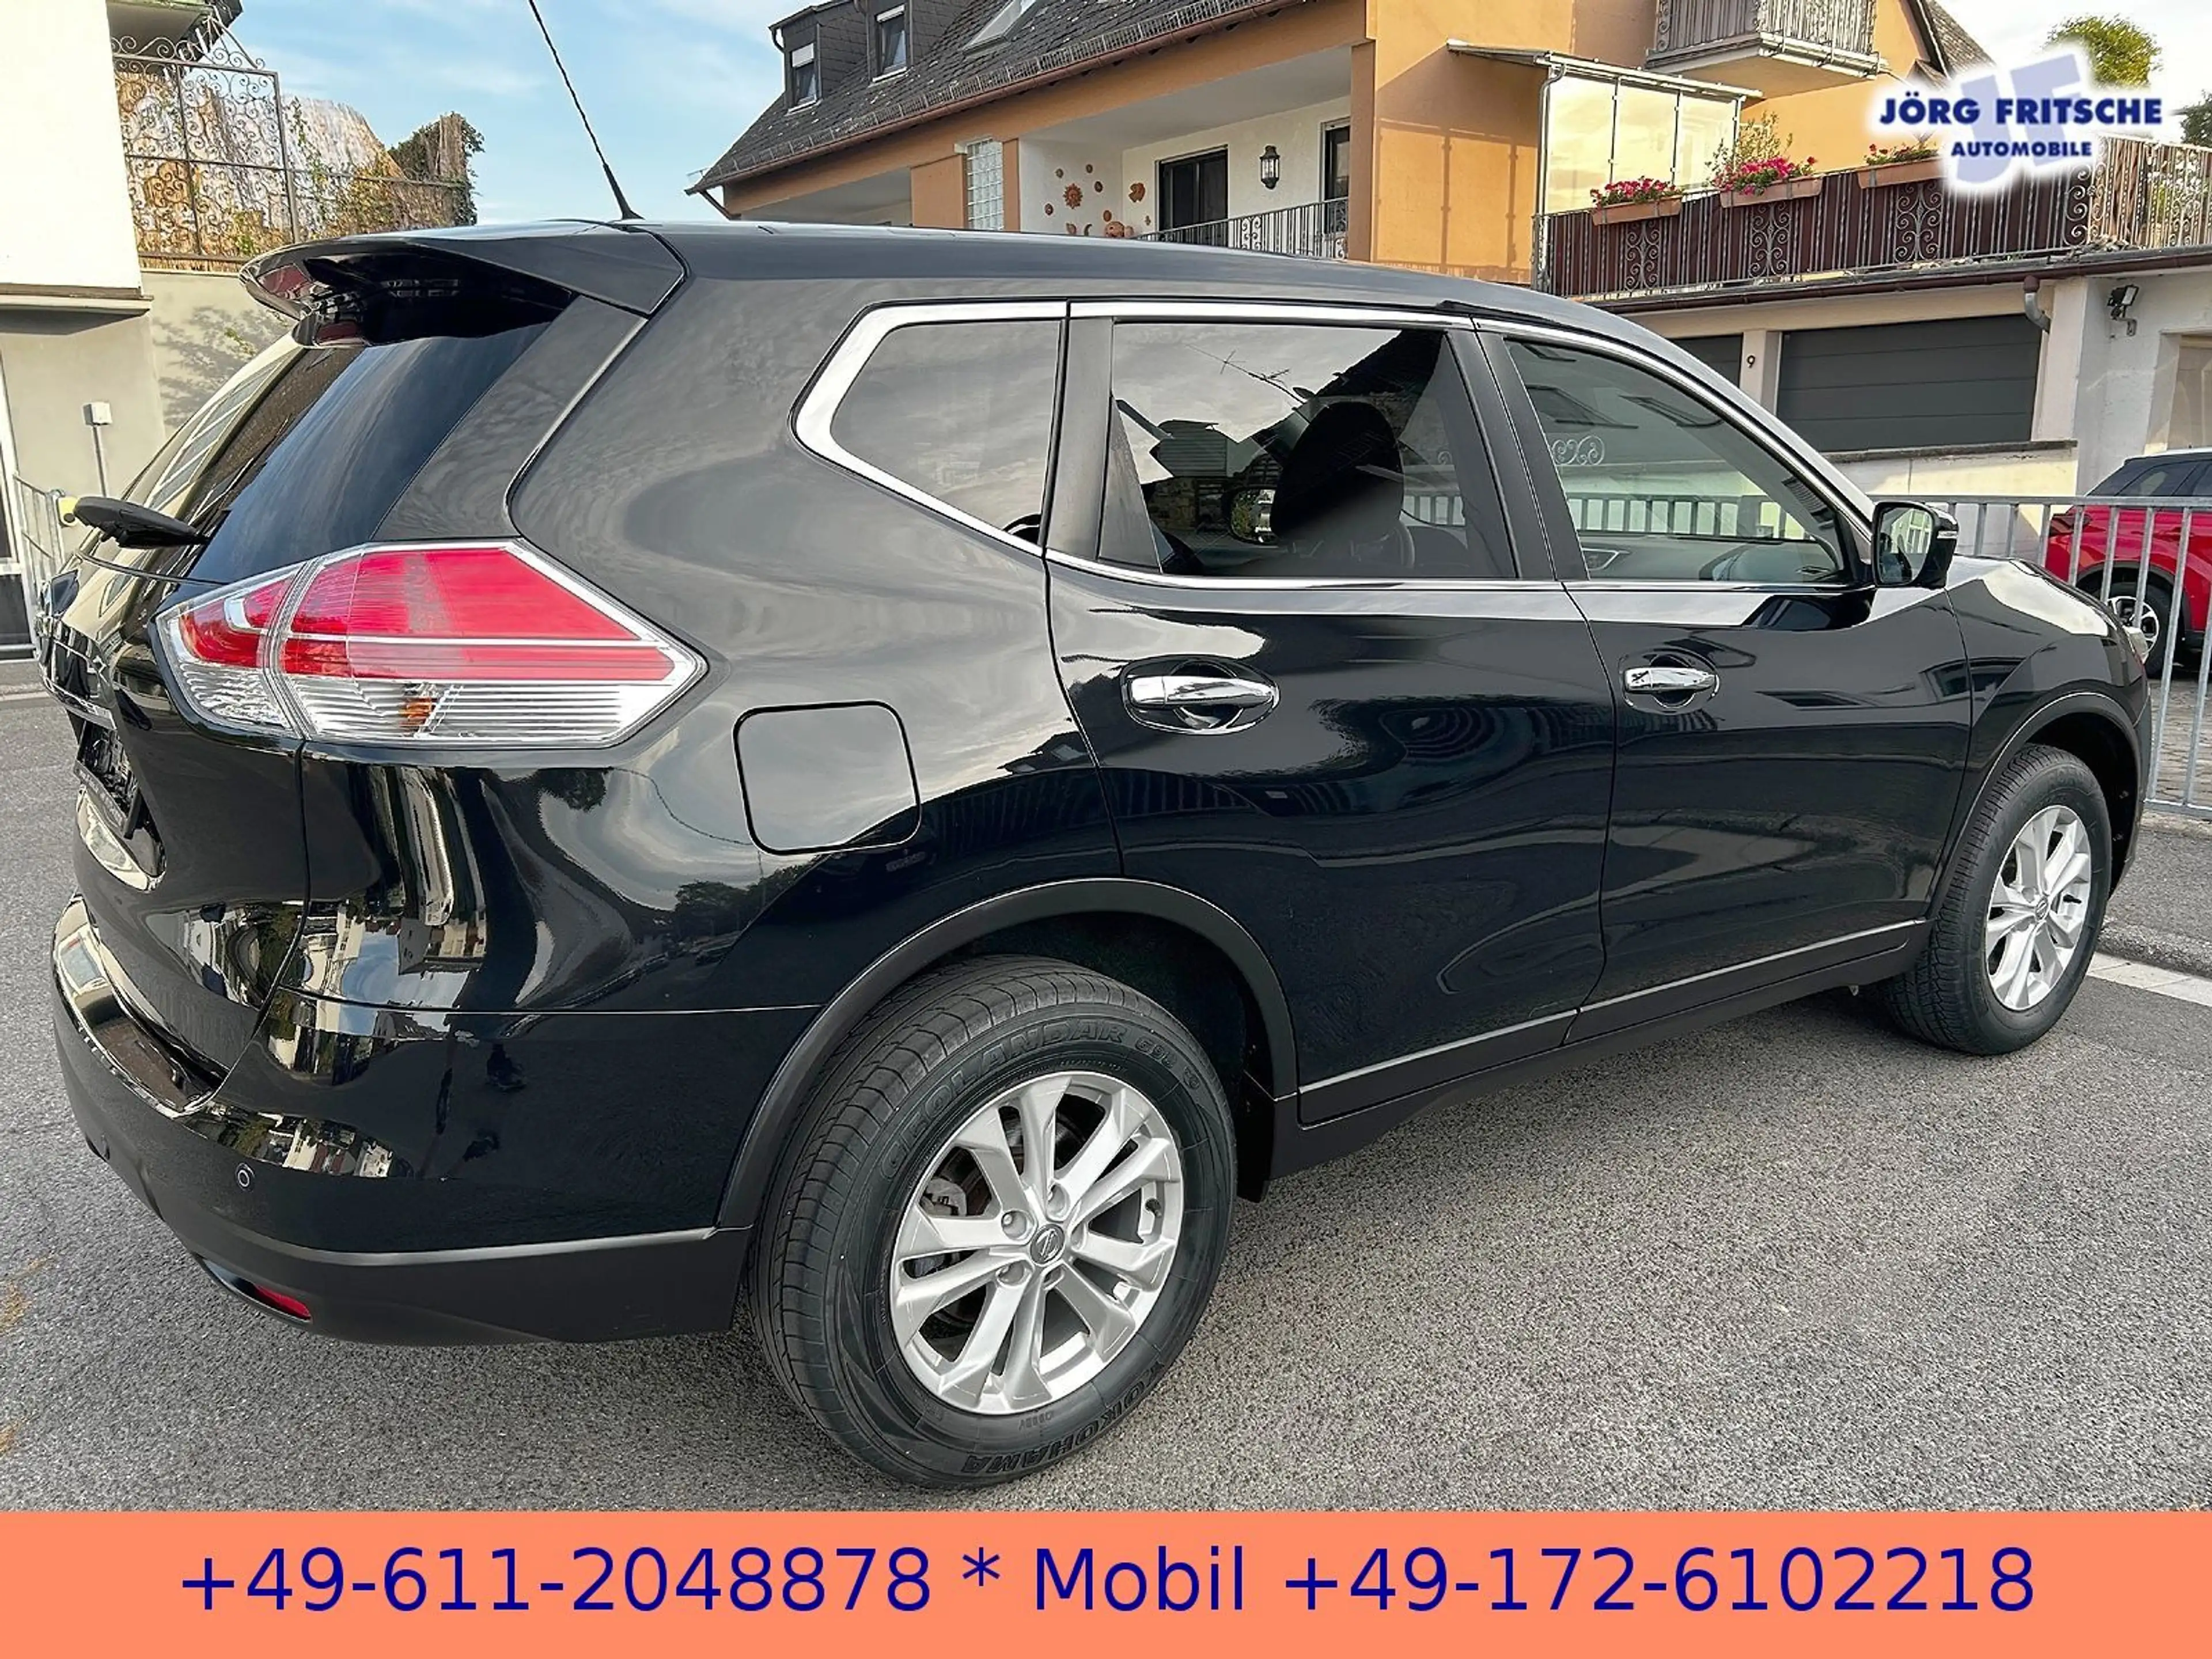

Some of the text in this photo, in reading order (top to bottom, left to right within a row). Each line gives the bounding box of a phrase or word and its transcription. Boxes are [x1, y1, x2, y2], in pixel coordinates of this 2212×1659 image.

[1746, 355, 1756, 369] 9
[880, 1018, 1128, 1179] GEOLANDAR
[961, 1361, 1165, 1474] YOKOHAMA
